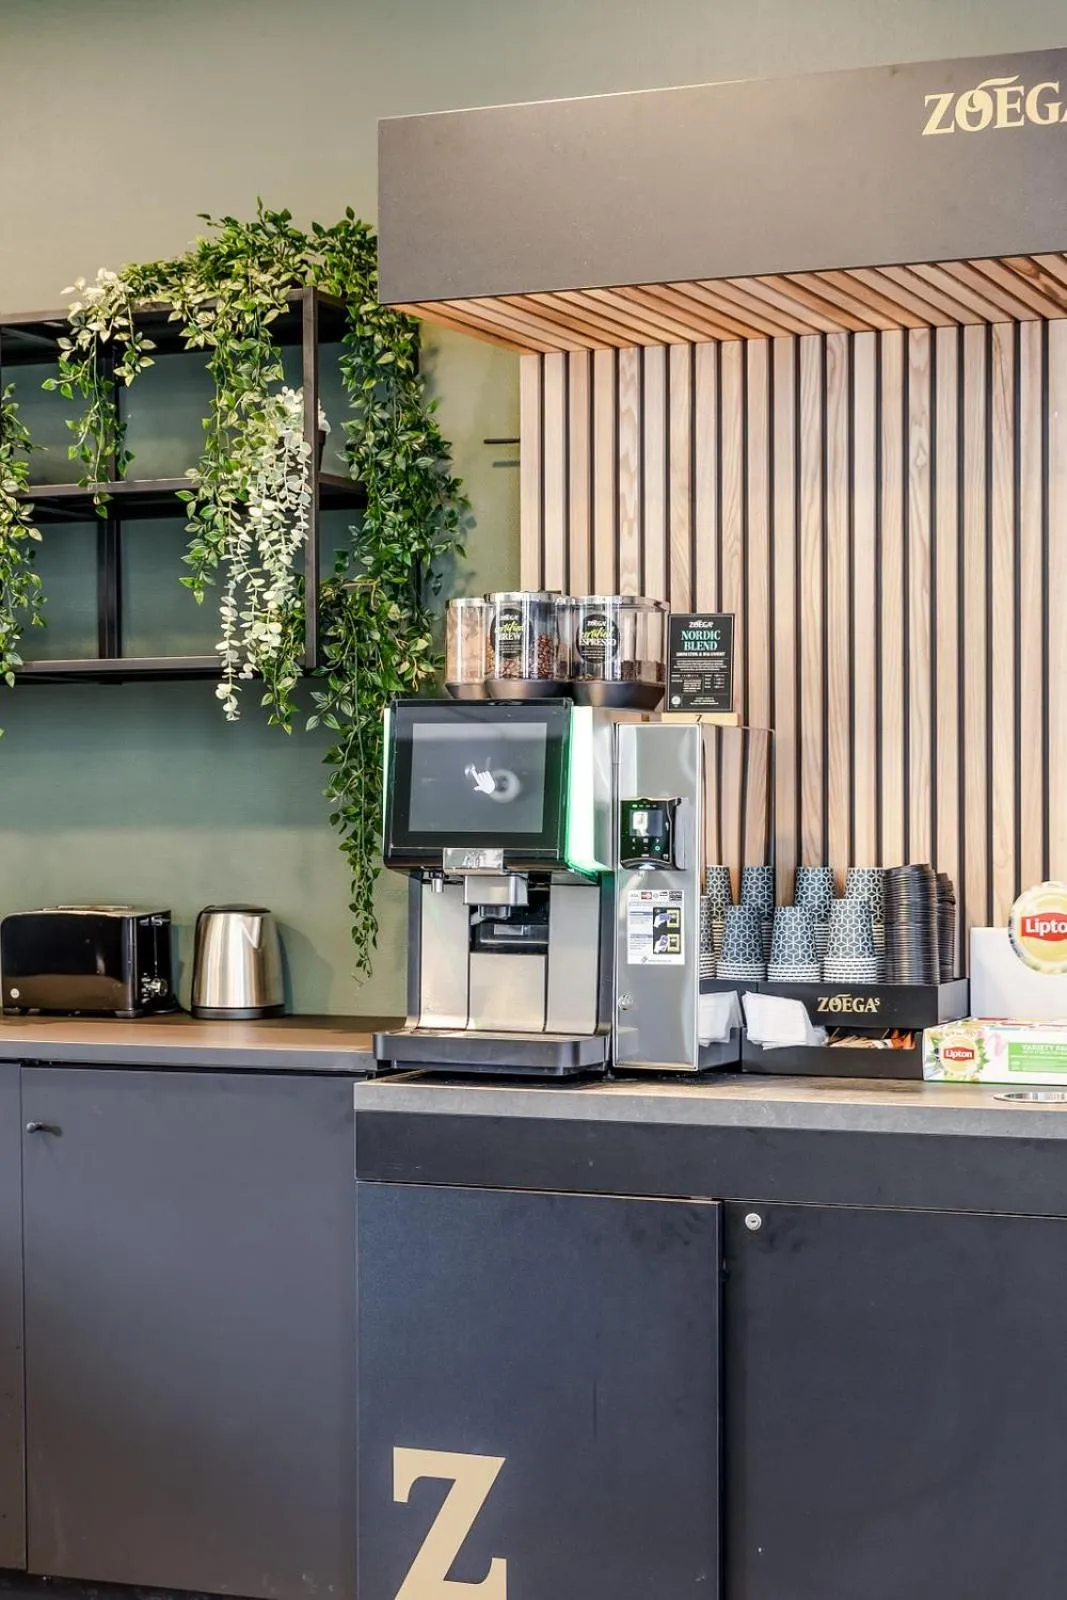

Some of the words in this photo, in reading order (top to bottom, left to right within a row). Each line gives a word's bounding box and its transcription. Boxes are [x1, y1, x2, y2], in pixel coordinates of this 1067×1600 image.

[681, 630, 721, 641] NORDIC
[684, 640, 718, 651] BLEND
[945, 1049, 973, 1060] Lipton
[392, 1446, 508, 1600] Z
